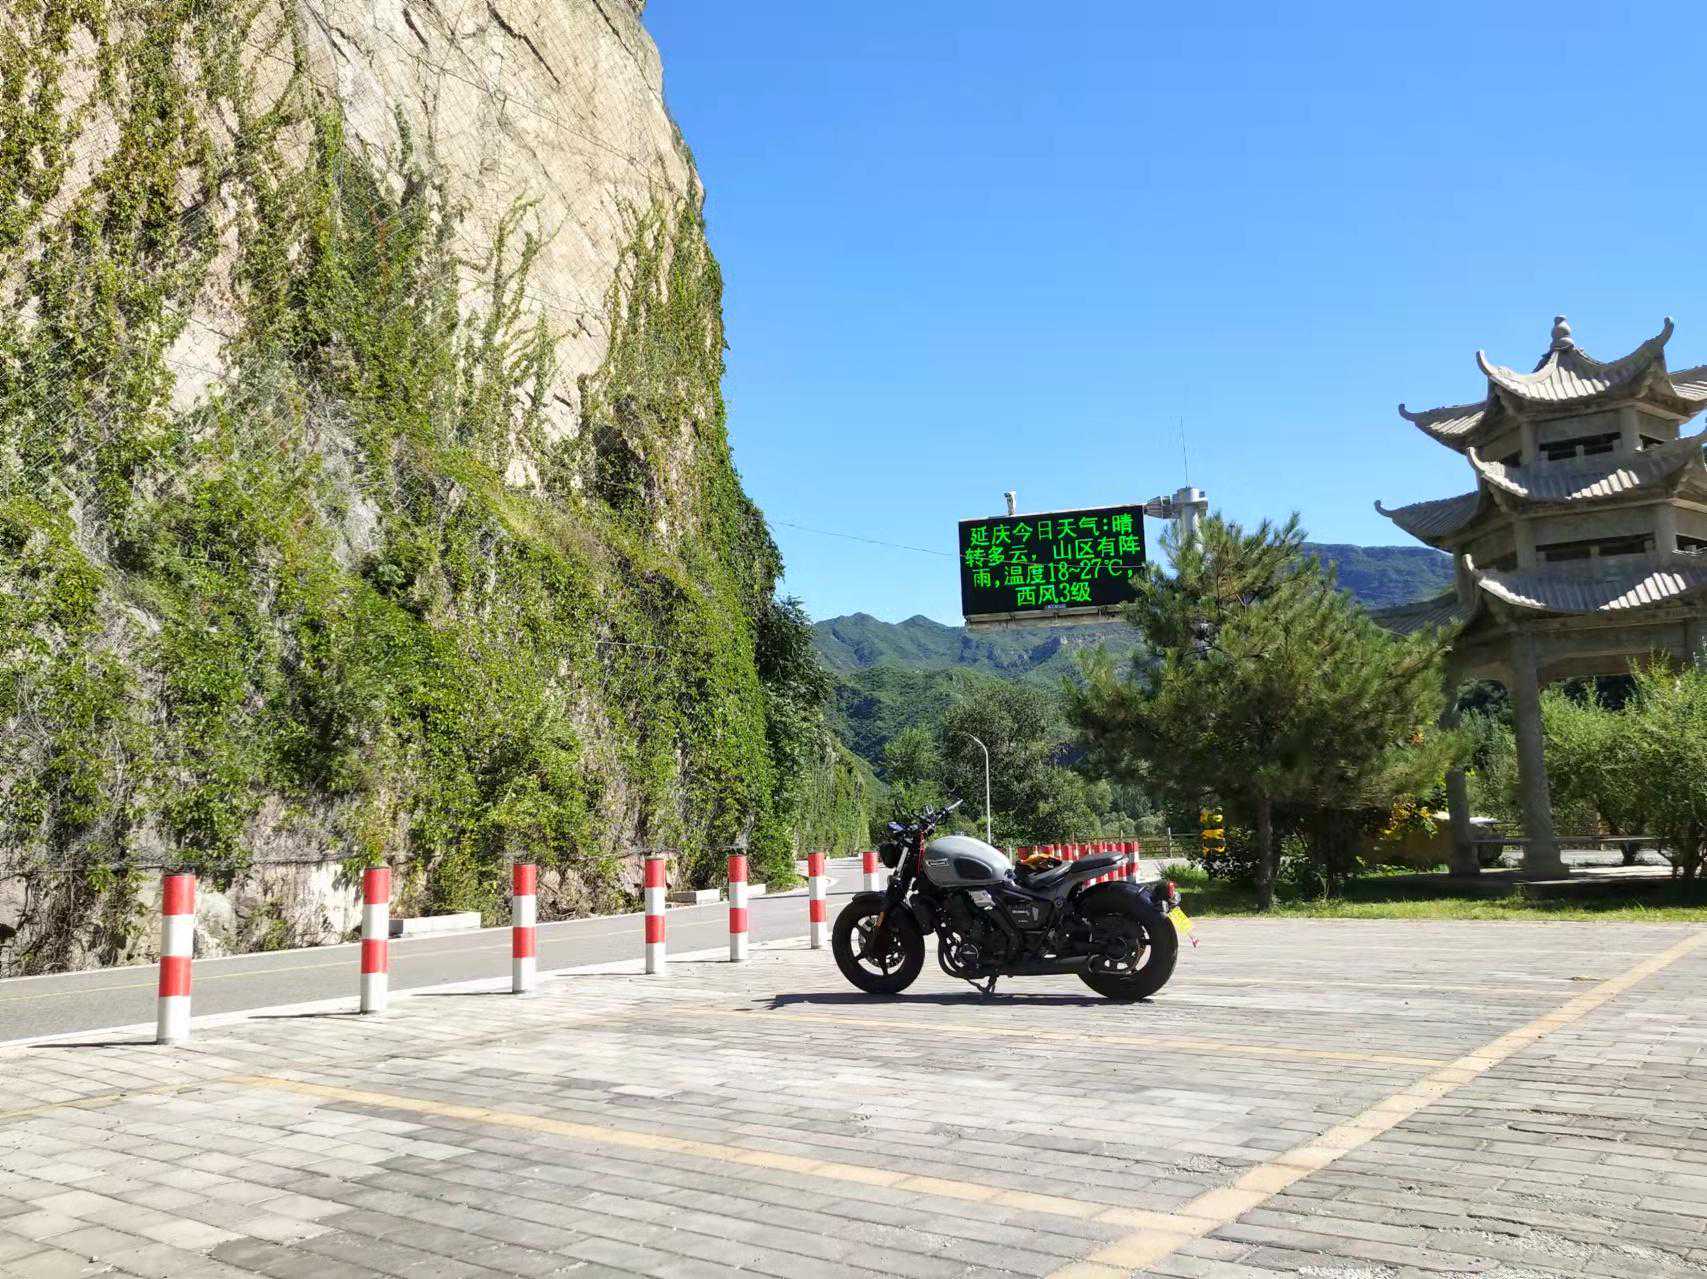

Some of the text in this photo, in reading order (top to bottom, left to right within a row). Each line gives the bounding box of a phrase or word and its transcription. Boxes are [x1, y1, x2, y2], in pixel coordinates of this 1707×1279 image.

[970, 514, 1133, 546] 延庆今日天气:晴
[1015, 582, 1092, 606] 西风3级
